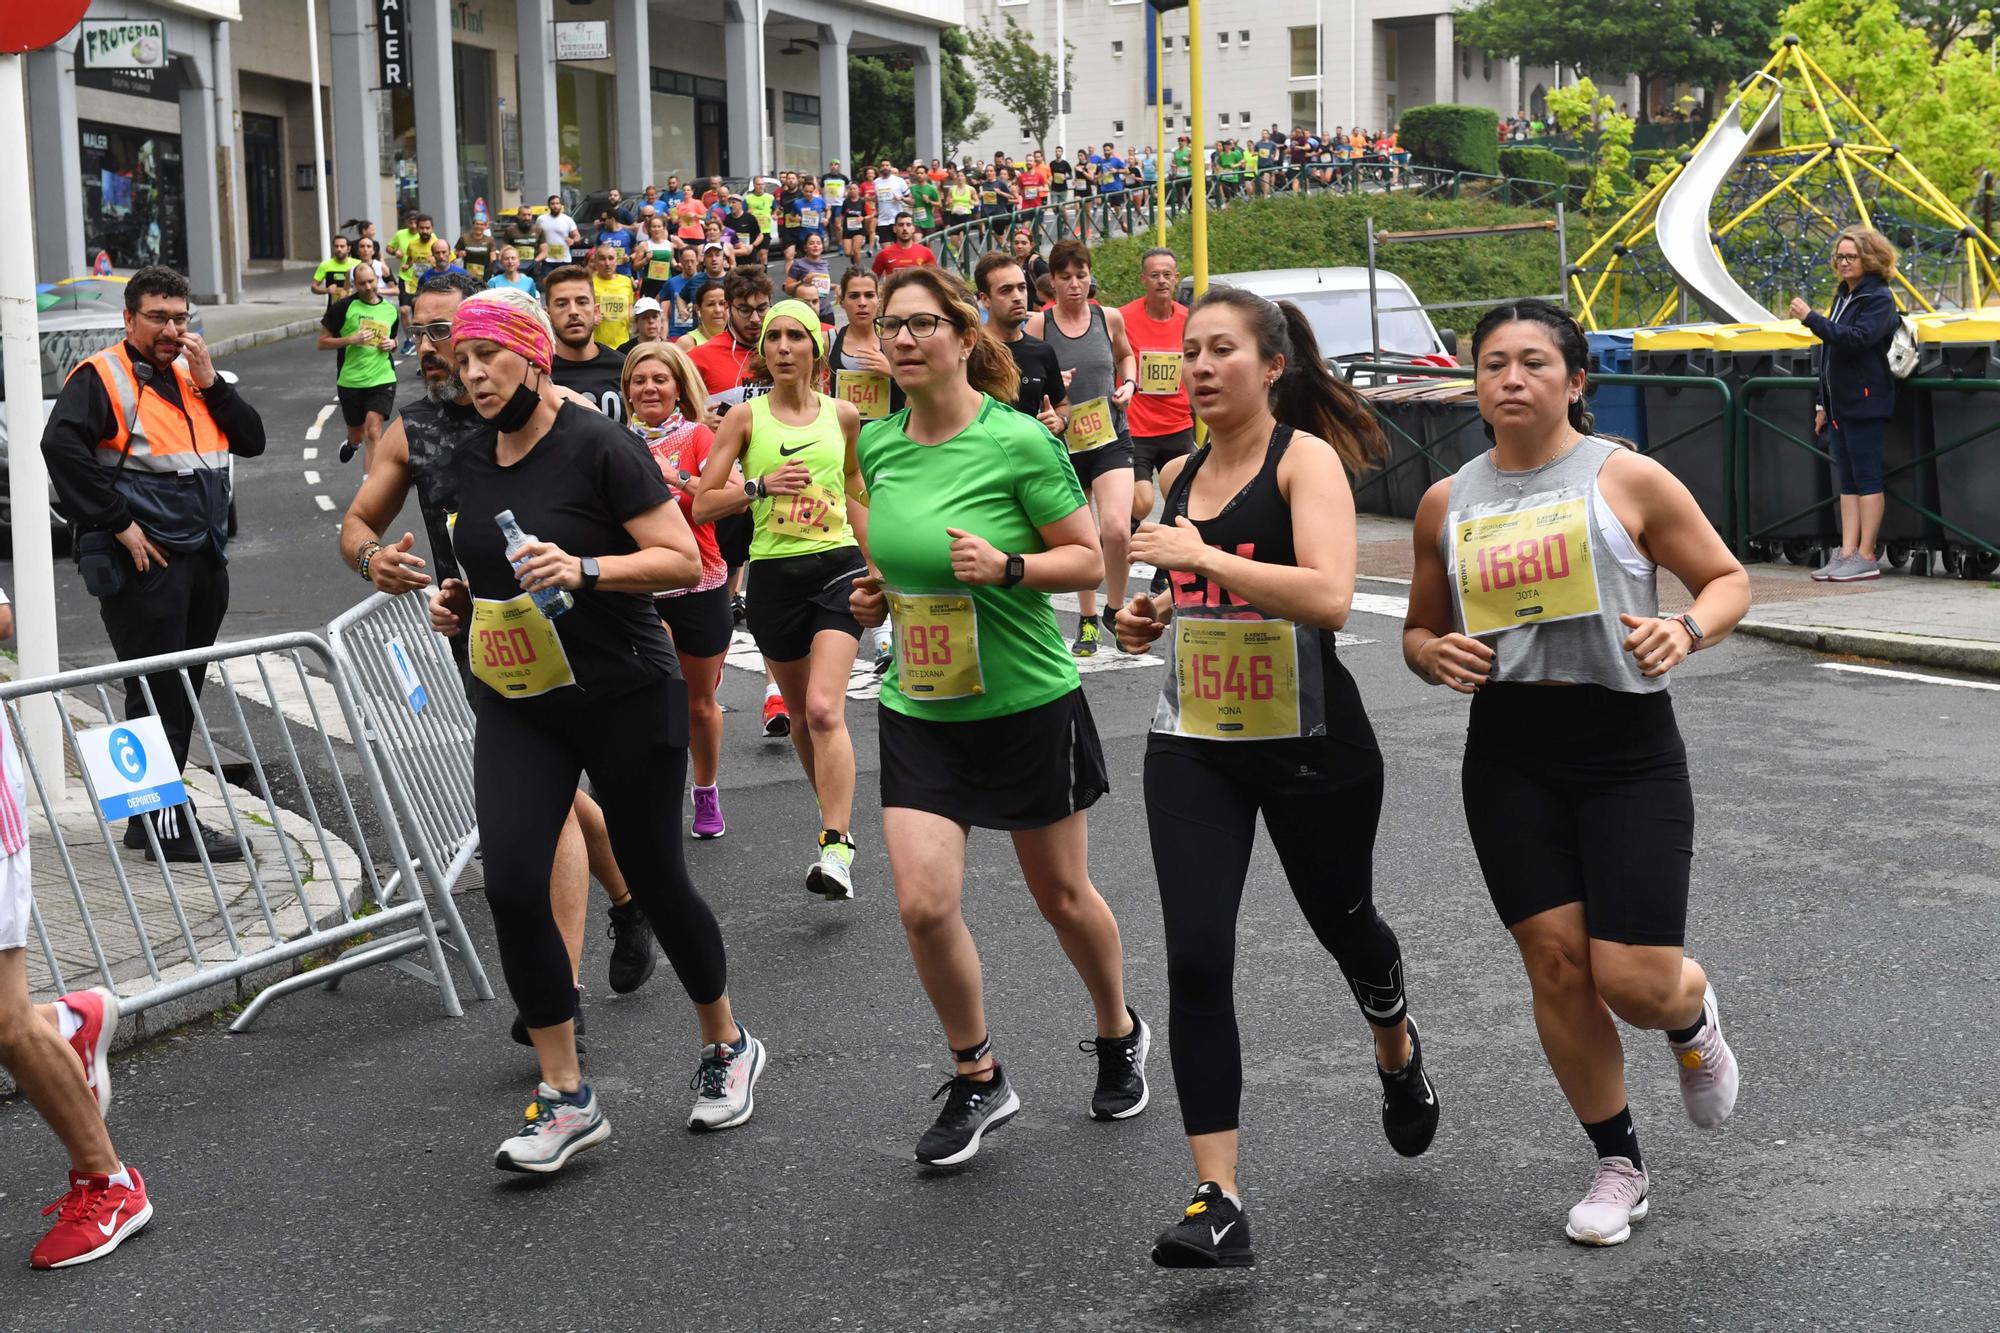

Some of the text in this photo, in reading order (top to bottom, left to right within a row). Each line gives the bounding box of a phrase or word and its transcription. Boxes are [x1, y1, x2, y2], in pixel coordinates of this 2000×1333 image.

[86, 24, 159, 62] FRUTERIA
[83, 133, 107, 149] MALER
[605, 302, 624, 313] 1798
[1147, 364, 1177, 380] 1802
[847, 384, 878, 403] 1541
[1073, 412, 1102, 436] 496
[789, 495, 829, 528] 182
[1460, 559, 1468, 587] TANDA
[1476, 533, 1570, 593] 1680
[1516, 589, 1540, 601] JOTA
[479, 627, 537, 668] 360
[1192, 654, 1274, 701] 1546
[1218, 706, 1242, 716] MONA
[126, 792, 161, 809] DEPORTES
